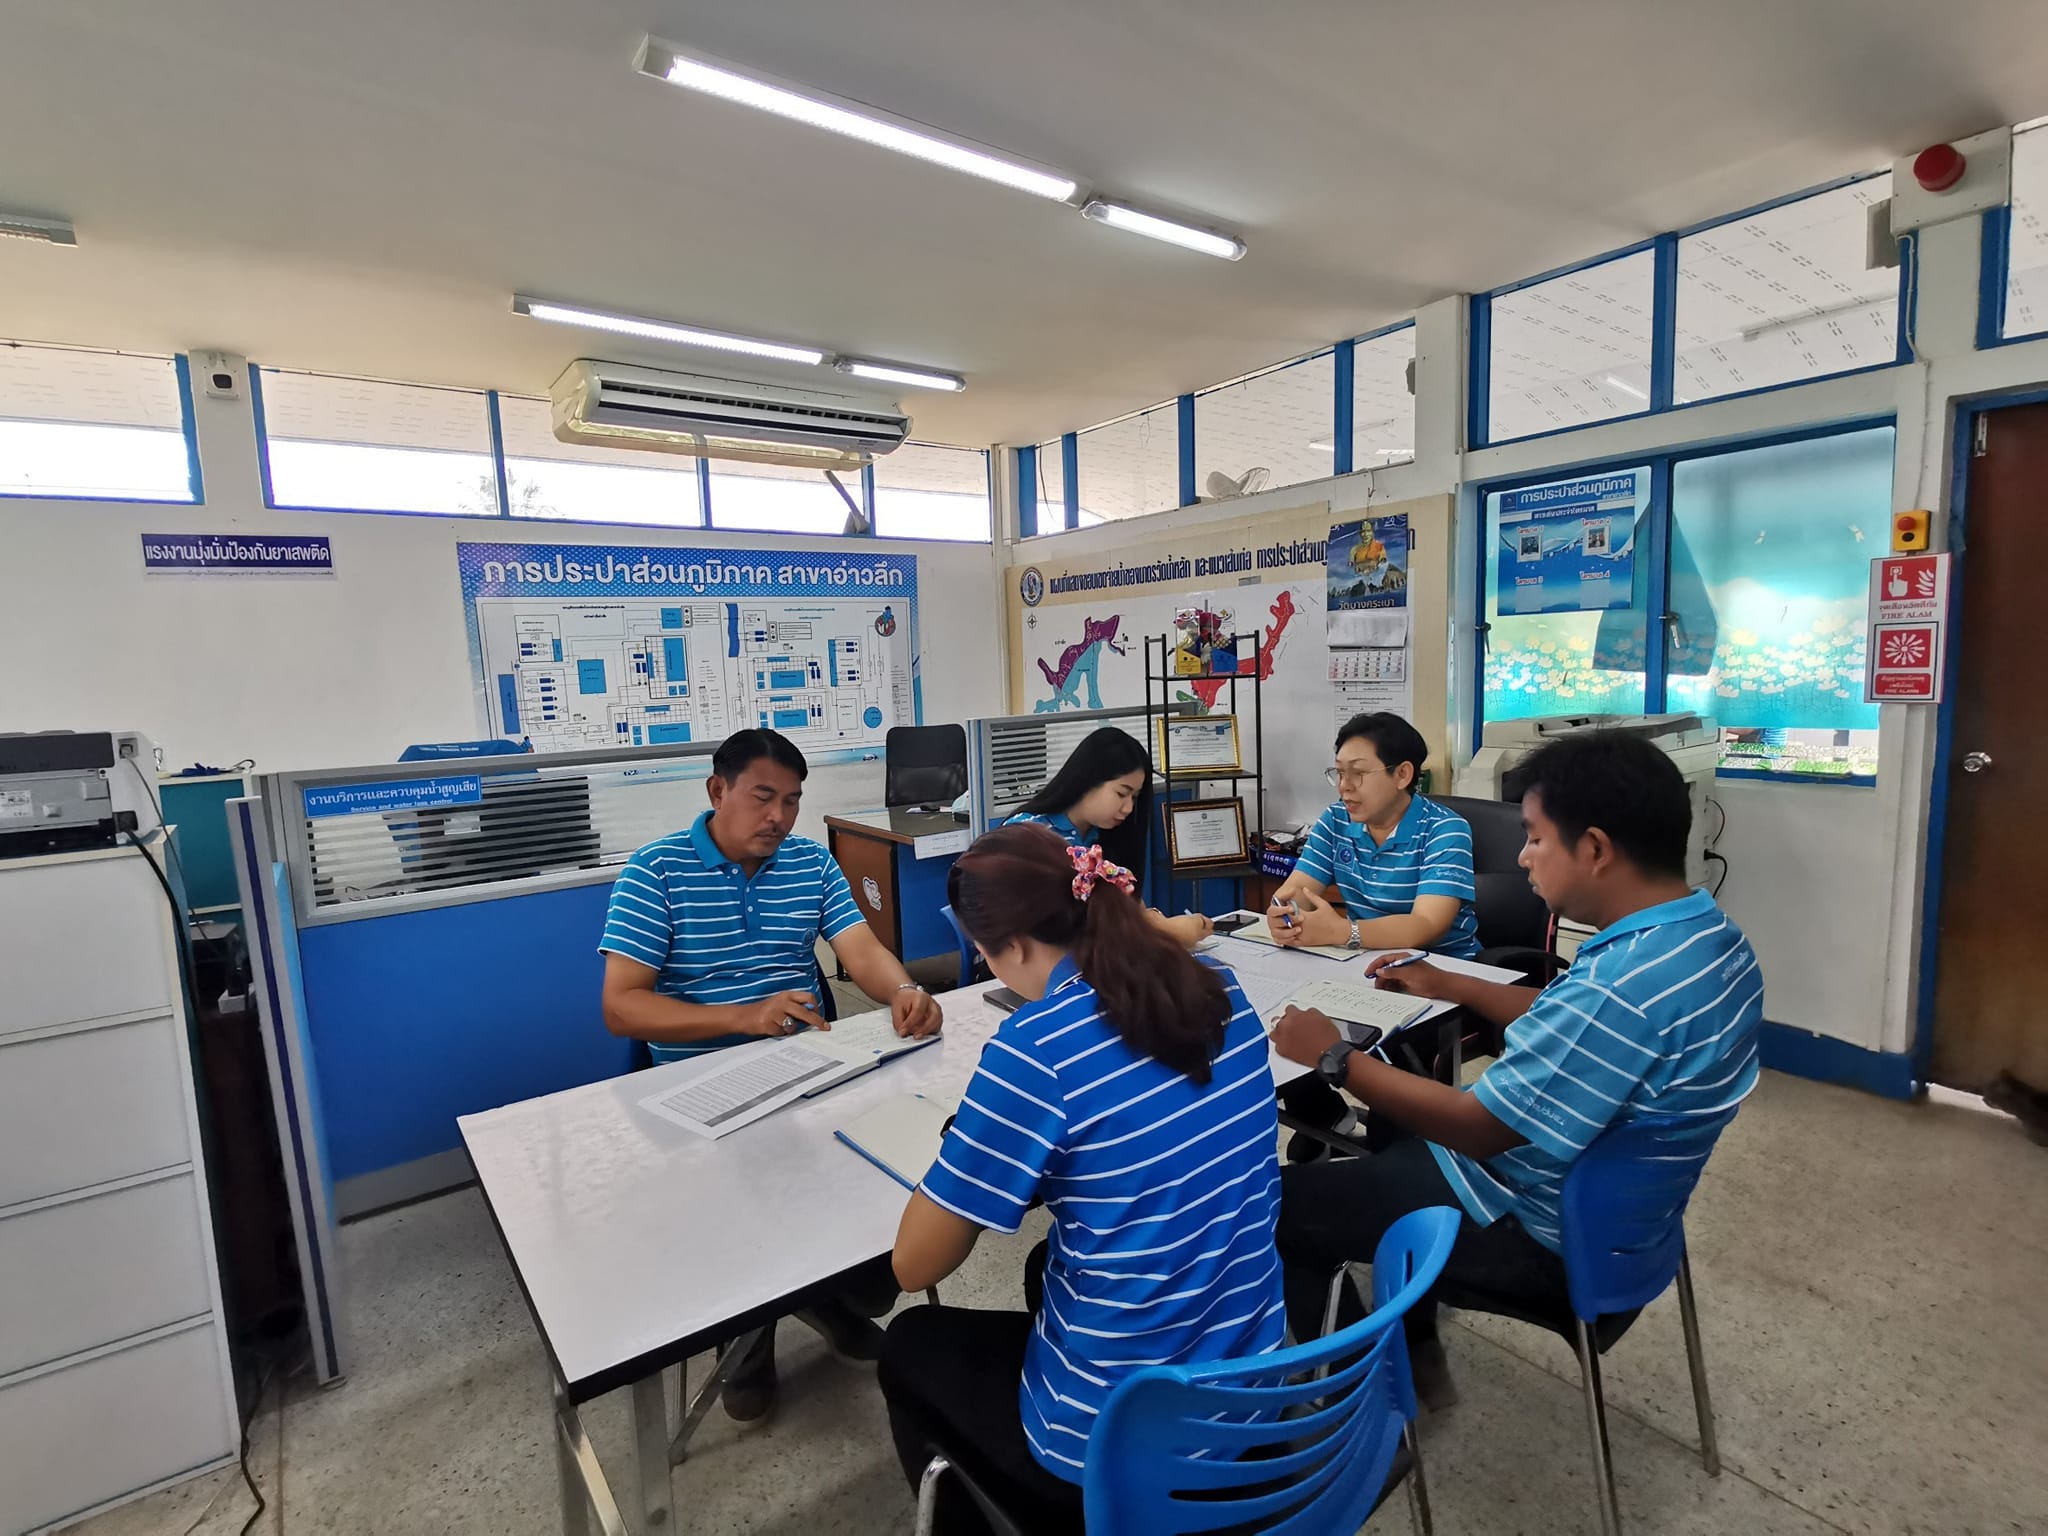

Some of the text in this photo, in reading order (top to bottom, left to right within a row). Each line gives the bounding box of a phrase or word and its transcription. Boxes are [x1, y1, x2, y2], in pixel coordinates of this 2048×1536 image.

[1520, 478, 1632, 504] การประปาส่วนภูมิภาค
[145, 537, 330, 565] แรงงานมุ่งมั่นป้องกันยาเสพติด
[1257, 537, 1329, 567] การประปาส่วนภู
[483, 554, 904, 593] การประปาส่วนภูมิภาค สาขาอ่าวลึก
[309, 781, 477, 805] งานบริการและควบคุมน้ำสูญเสีย
